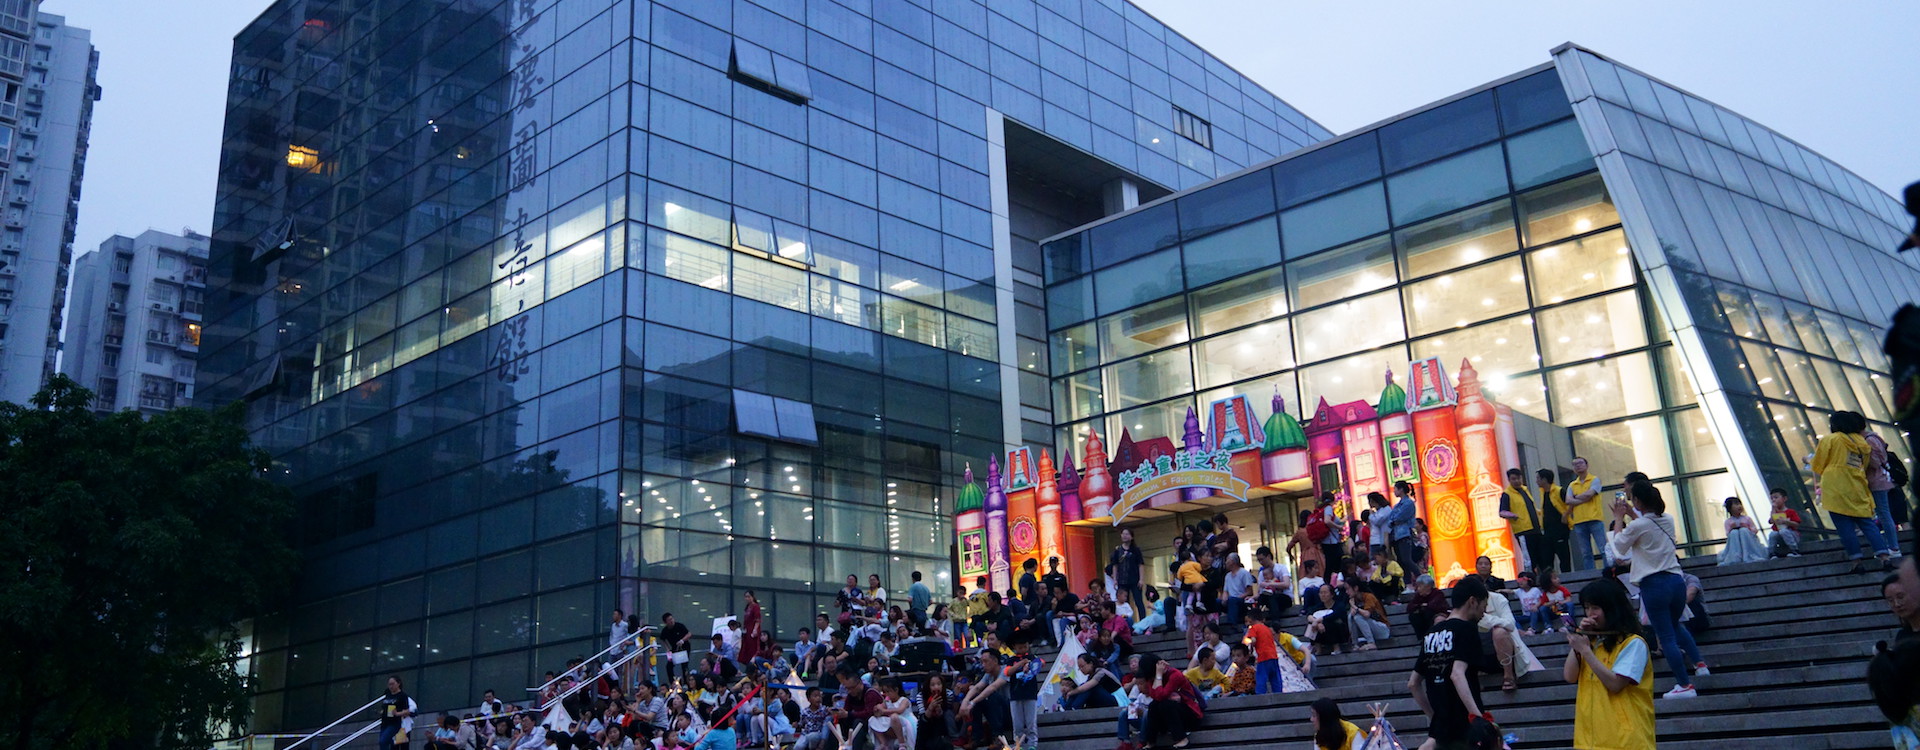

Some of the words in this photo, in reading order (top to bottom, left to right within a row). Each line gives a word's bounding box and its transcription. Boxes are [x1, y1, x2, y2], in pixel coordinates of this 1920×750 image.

[1118, 451, 1232, 490] 格林童话之夜
[1170, 475, 1194, 485] Fairy
[1198, 474, 1224, 484] Tales
